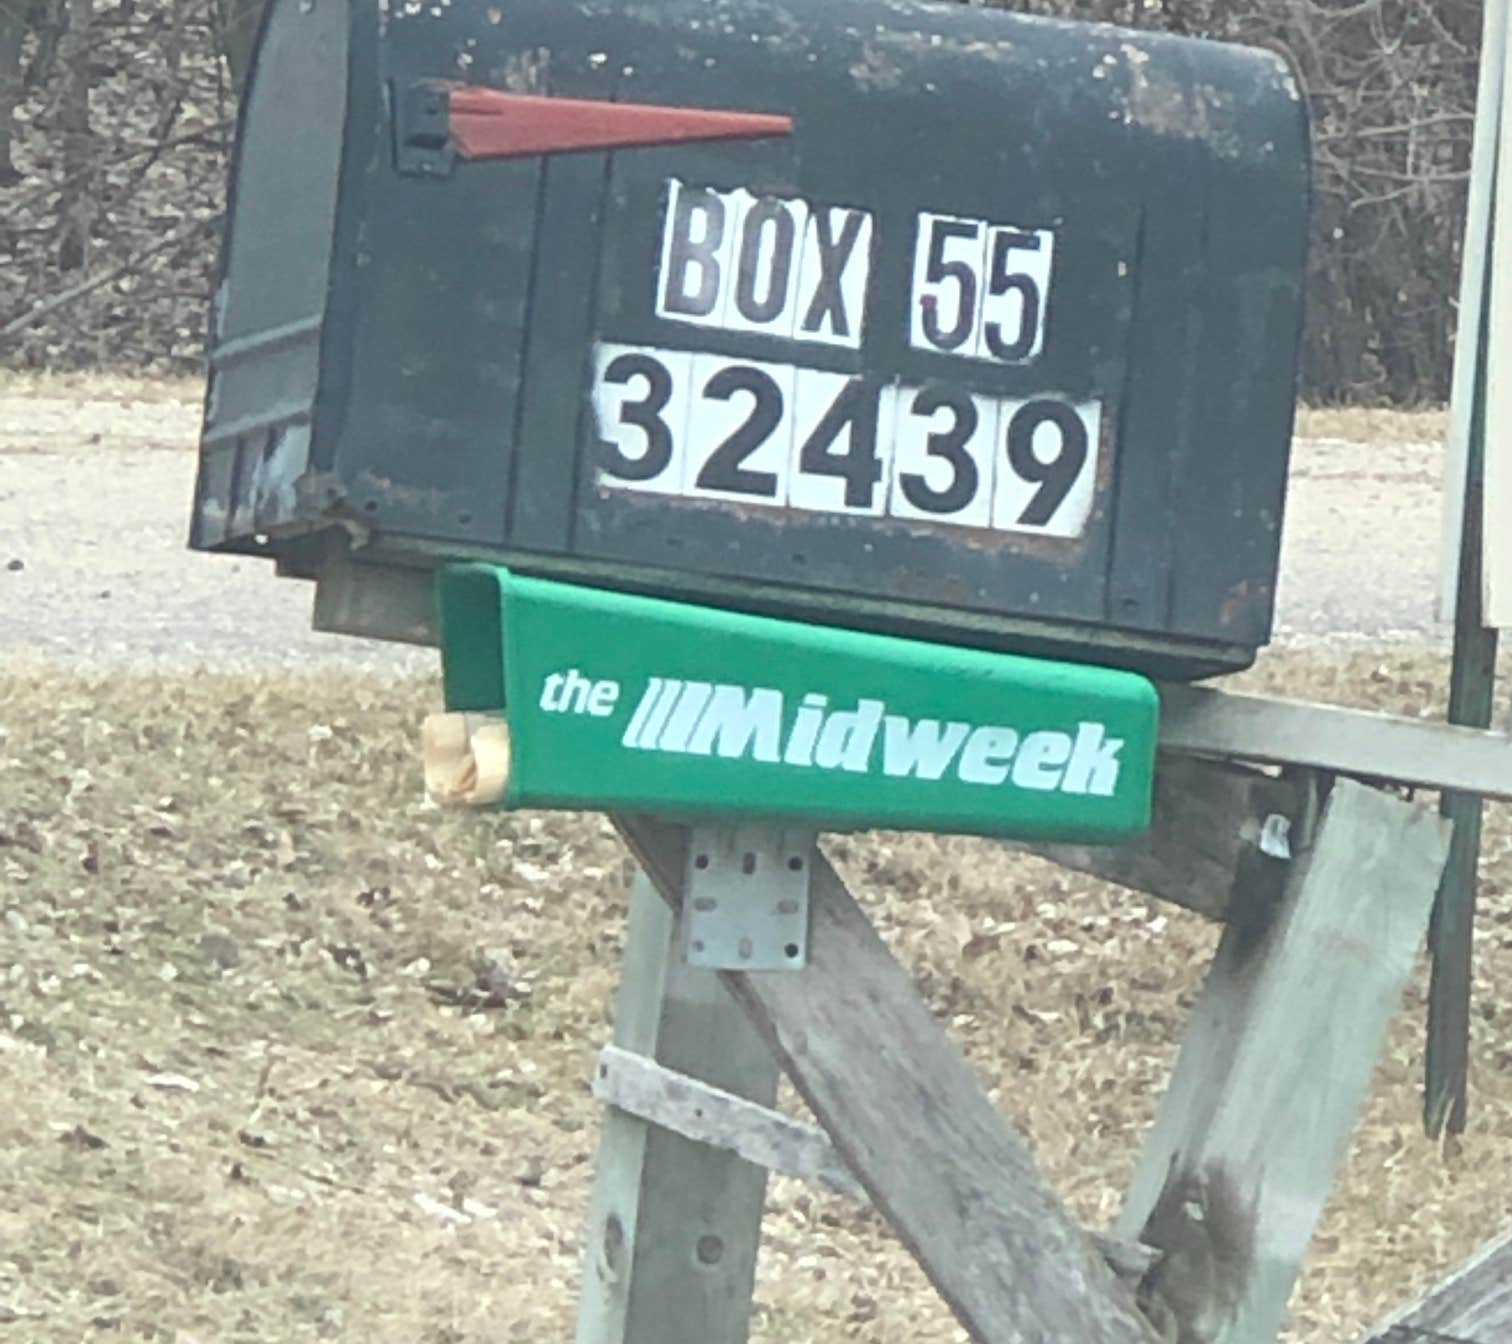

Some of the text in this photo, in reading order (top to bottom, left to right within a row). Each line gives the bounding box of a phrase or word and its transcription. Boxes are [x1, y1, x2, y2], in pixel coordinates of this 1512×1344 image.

[665, 190, 1041, 358] BOX 55
[601, 355, 1088, 526] 32439
[541, 669, 1124, 797] the Midweek
